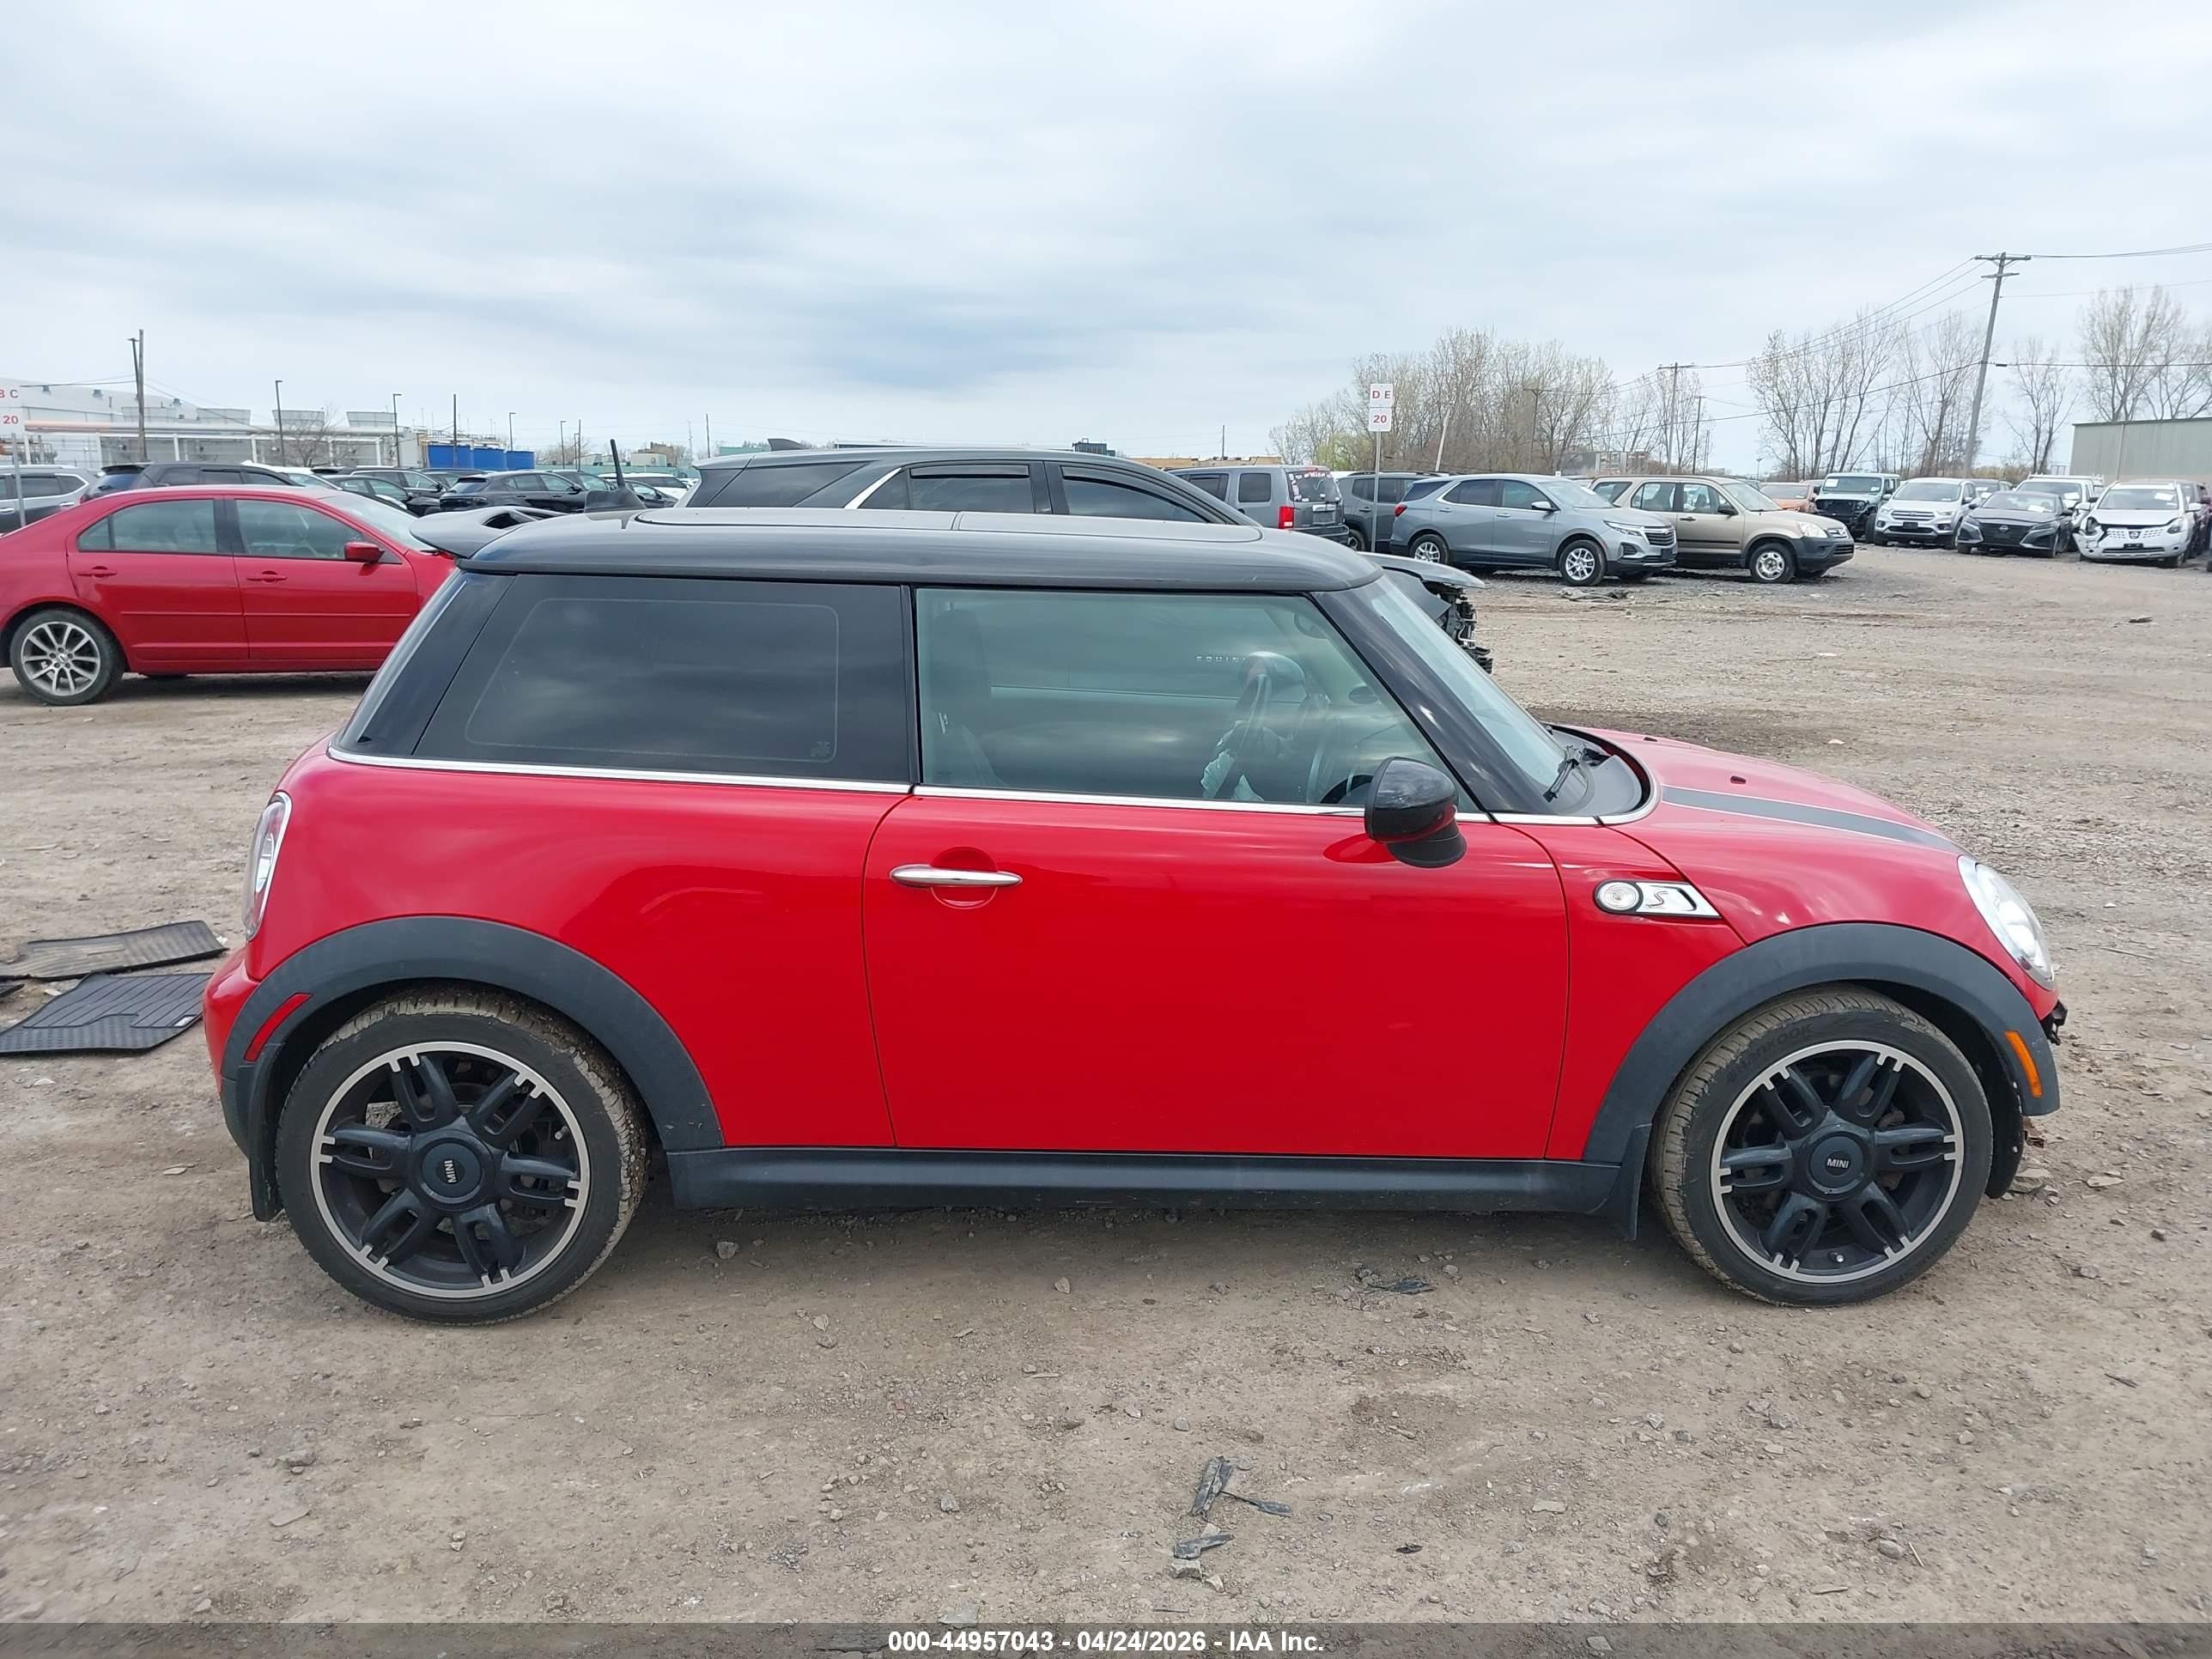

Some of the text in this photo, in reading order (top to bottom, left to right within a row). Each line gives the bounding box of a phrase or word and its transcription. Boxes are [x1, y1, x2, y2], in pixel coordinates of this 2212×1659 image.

[9, 389, 19, 398] C
[1372, 390, 1392, 399] D E
[3, 415, 19, 424] 20
[1373, 415, 1388, 423] 20
[1826, 1158, 1850, 1169] MINI
[444, 1159, 458, 1183] MINI
